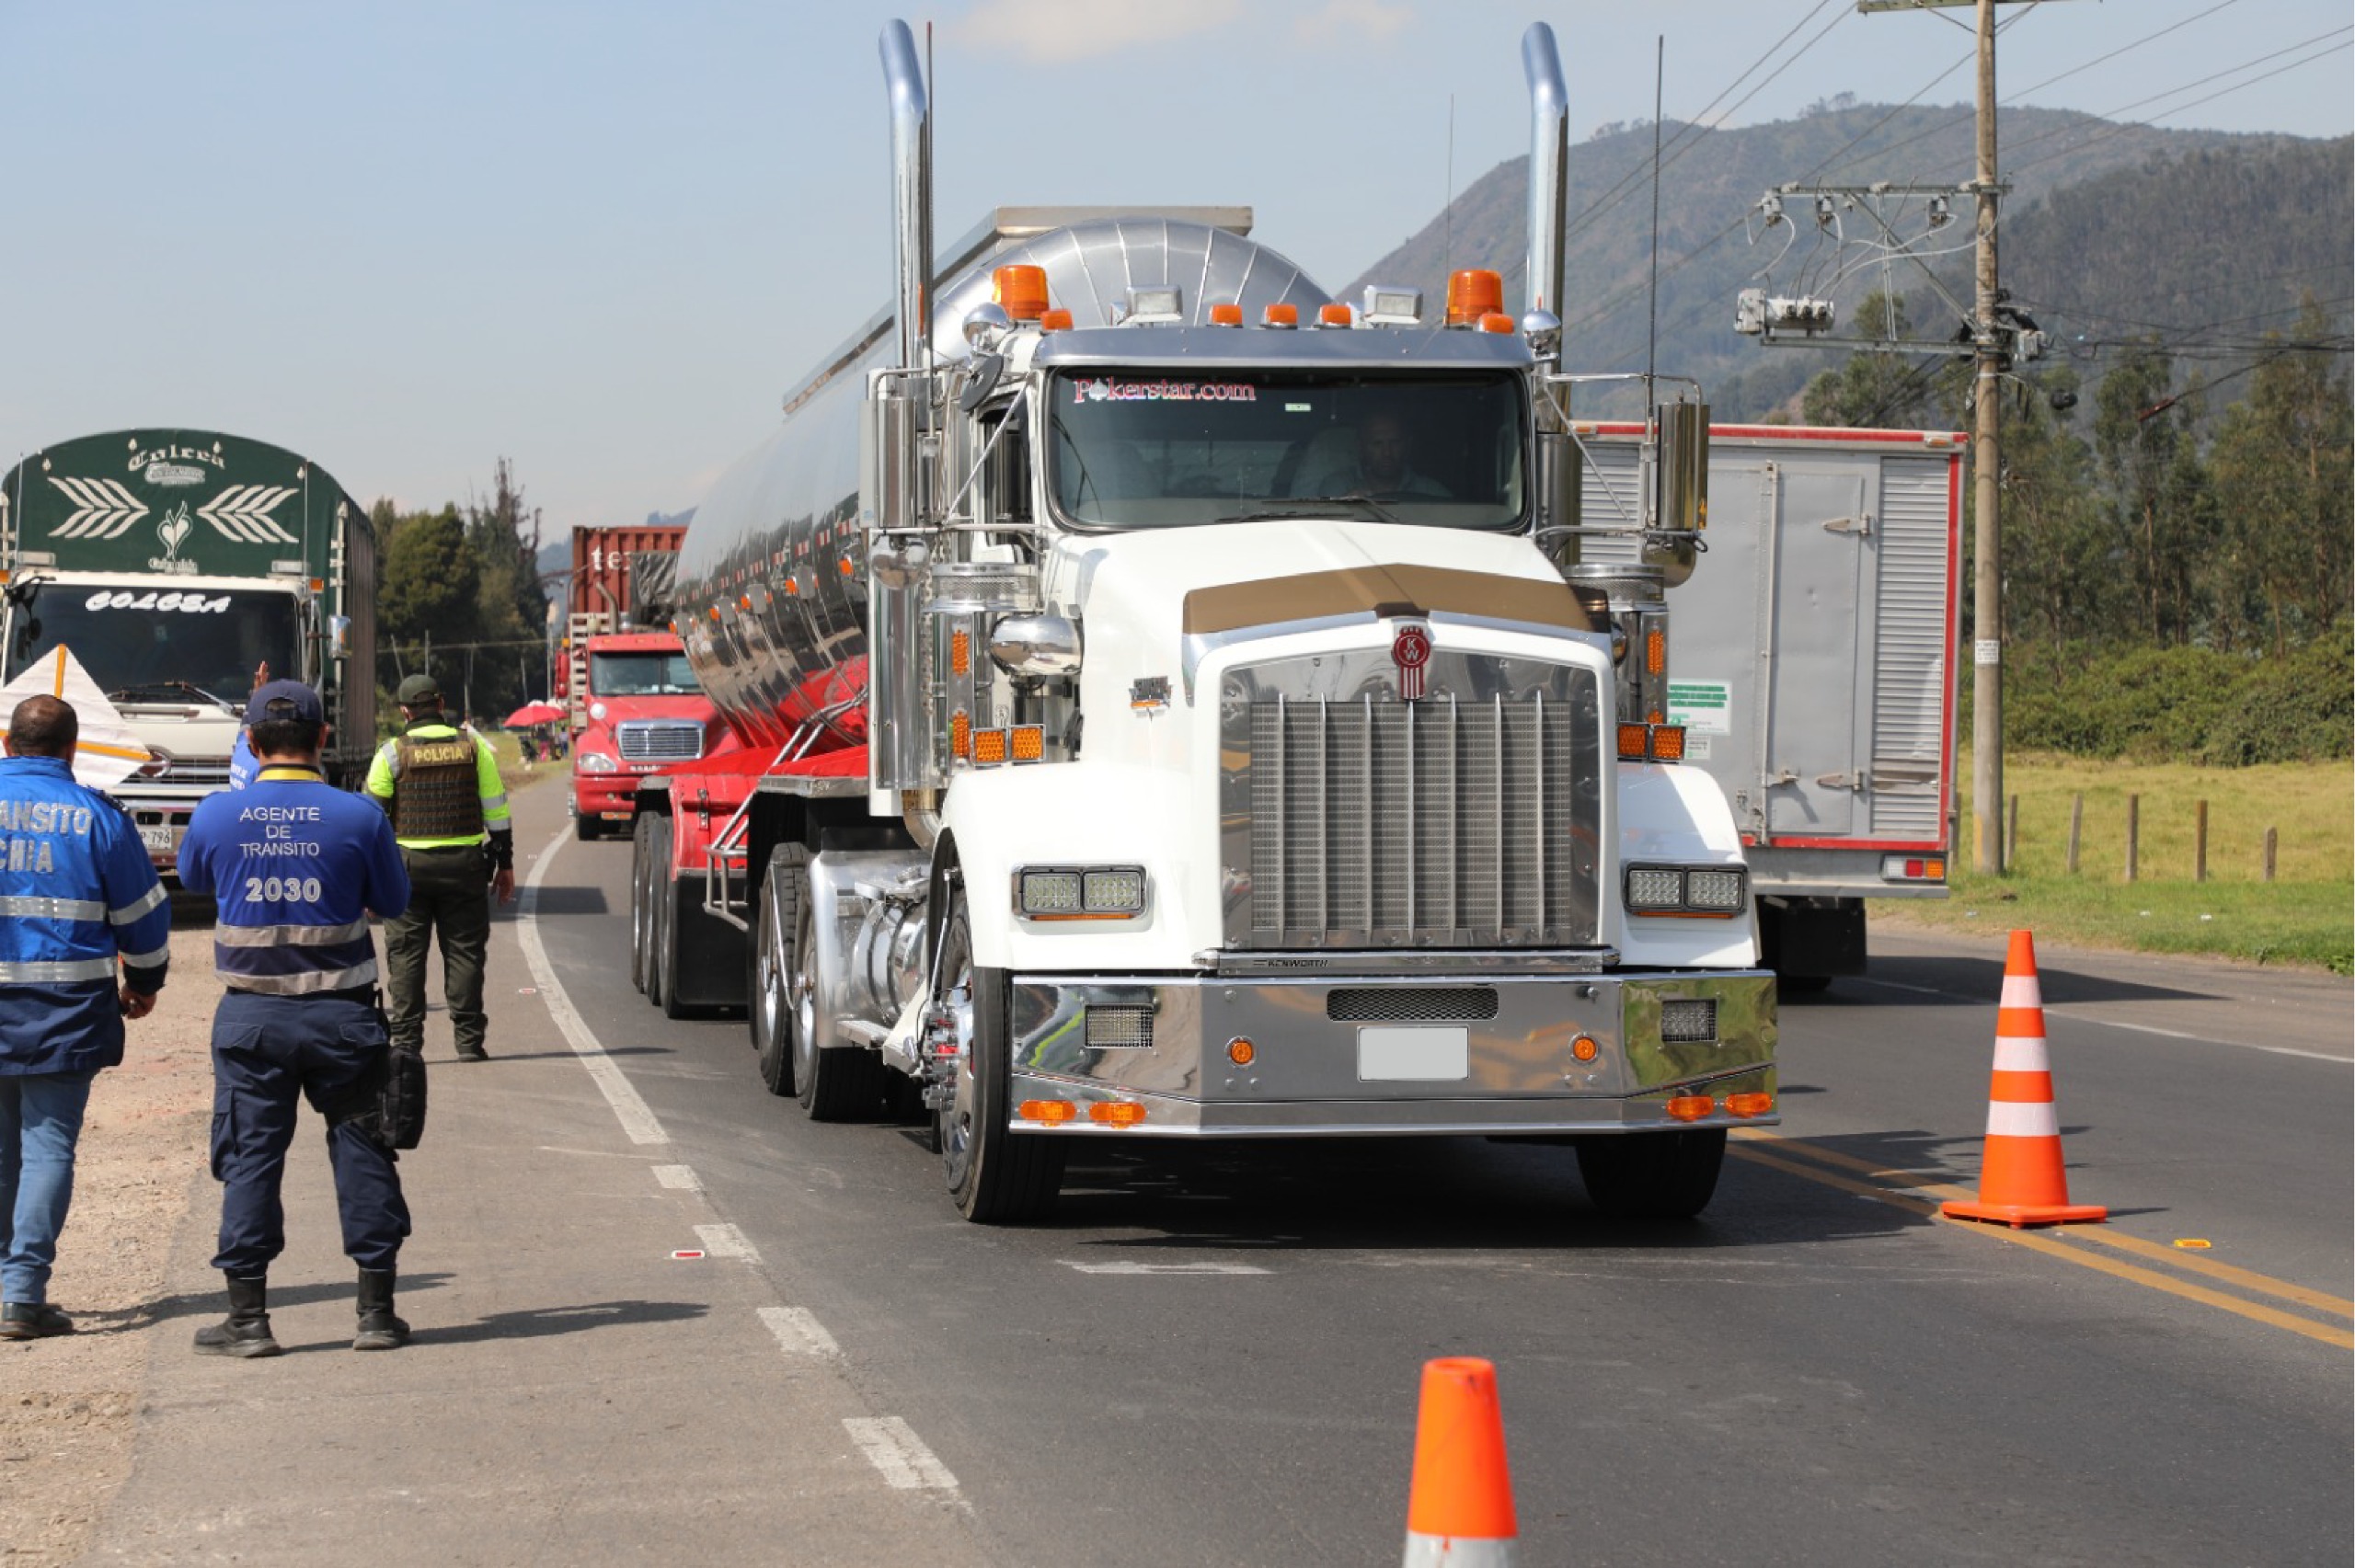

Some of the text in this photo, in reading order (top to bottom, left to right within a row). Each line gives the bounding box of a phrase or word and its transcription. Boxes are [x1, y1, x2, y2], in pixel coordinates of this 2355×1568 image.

[86, 590, 232, 613] COLCEA
[414, 746, 464, 764] POLICIA
[239, 807, 320, 822] AGENTE
[265, 824, 292, 839] DE
[239, 842, 320, 858] TRANSITO
[245, 876, 321, 903] 2030
